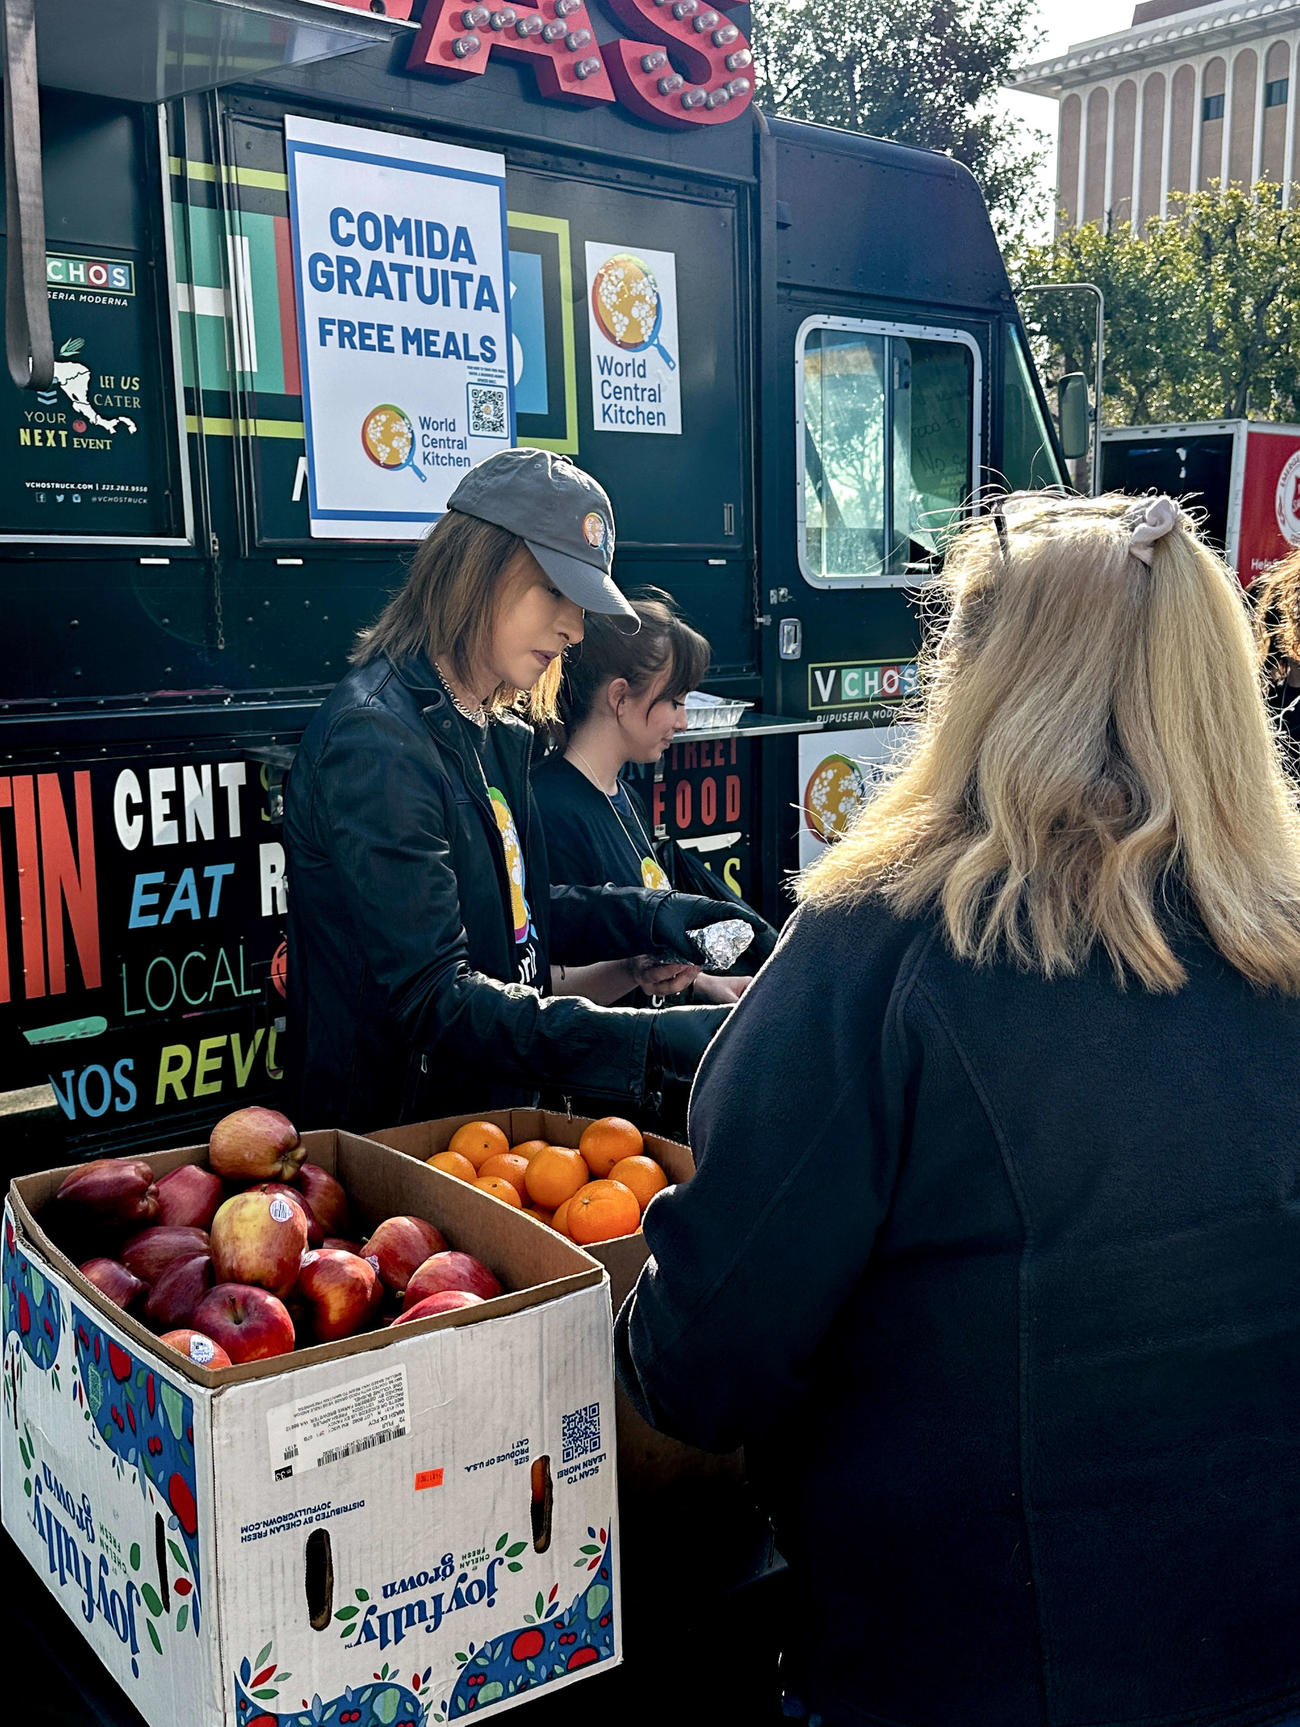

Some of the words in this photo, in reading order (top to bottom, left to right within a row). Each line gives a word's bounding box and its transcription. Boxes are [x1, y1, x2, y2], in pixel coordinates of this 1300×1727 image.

[329, 206, 477, 266] COMIDA
[47, 260, 128, 288] CHOS
[308, 251, 500, 313] GRATUITA
[47, 291, 76, 302] SERIA
[79, 293, 129, 307] MODERNA
[318, 316, 395, 354] FREE
[402, 325, 497, 364] MEALS
[597, 355, 646, 378] World
[100, 376, 115, 389] LET
[120, 376, 141, 391] US
[601, 380, 662, 403] Central
[94, 393, 142, 409] CATER
[24, 411, 67, 424] YOUR
[418, 416, 457, 433] World
[602, 403, 666, 427] Kitchen
[19, 428, 68, 448] NEXT
[73, 437, 113, 450] EVENT
[421, 434, 468, 451] Central
[422, 451, 471, 468] Kitchen
[25, 482, 94, 490] VCHOSTRUCK.COM
[814, 669, 917, 703] VCHOS
[816, 711, 869, 724] PUPUSERIA
[671, 737, 738, 771] TREET
[114, 761, 247, 851] CENT
[653, 774, 741, 830] FOOD
[128, 863, 235, 930] EAT
[122, 945, 261, 1017] LOCAL
[516, 1438, 529, 1448] CAT
[486, 1458, 495, 1466] OF
[496, 1447, 529, 1463] PRODUCE
[514, 1455, 529, 1466] SIZE
[583, 1453, 606, 1468] LEARN
[567, 1475, 578, 1484] TO
[579, 1466, 599, 1480] SCAN
[41, 1461, 95, 1544] grown
[315, 1500, 365, 1521] DISTRIBUTED
[241, 1502, 331, 1534] JOYFULLYGROWN.COM
[270, 1520, 302, 1535] CHELAN
[303, 1516, 313, 1525] BY
[98, 1521, 121, 1553] FRESH
[241, 1530, 268, 1543] FRESH
[460, 1554, 490, 1568] CHELAN
[462, 1547, 485, 1560] FRESH
[32, 1474, 141, 1679] joyfully
[382, 1553, 454, 1599] grown
[354, 1557, 504, 1650] joyfully
